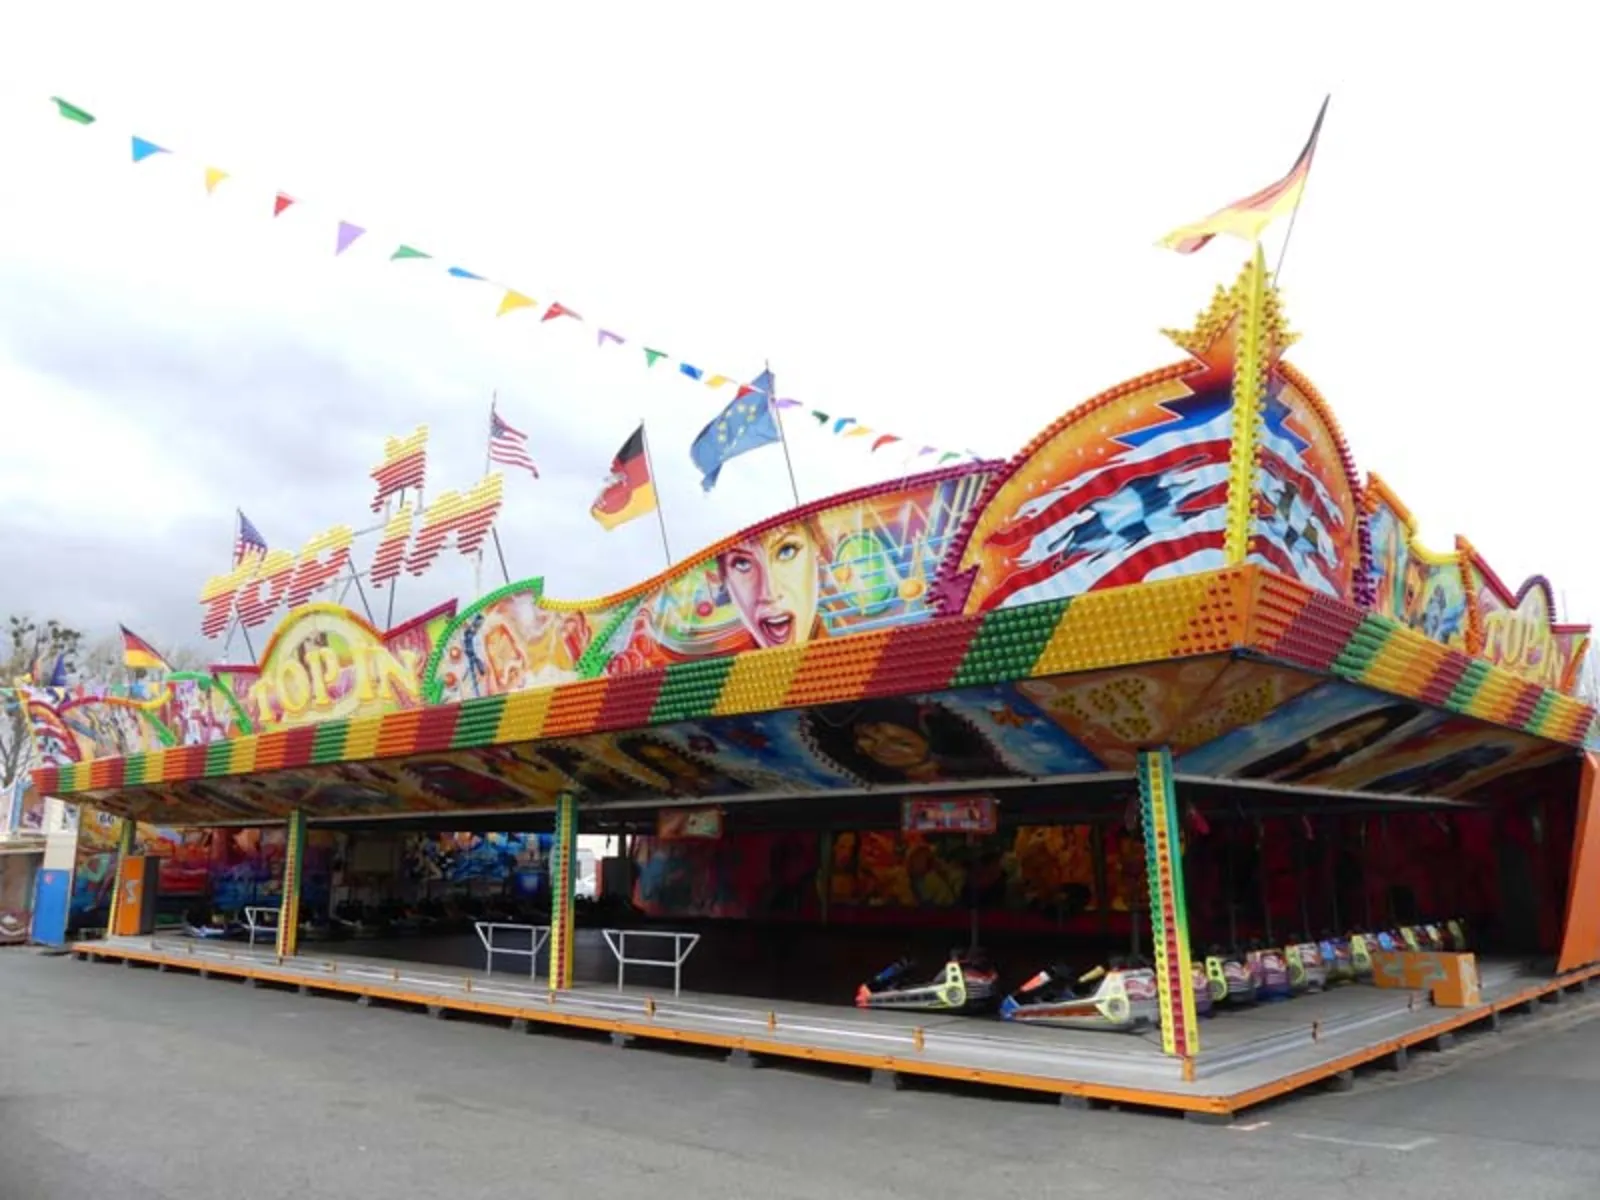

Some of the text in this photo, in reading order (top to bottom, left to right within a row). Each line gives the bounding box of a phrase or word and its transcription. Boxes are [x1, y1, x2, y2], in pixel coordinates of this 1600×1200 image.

[200, 473, 502, 639] TOP IN
[249, 643, 422, 722] TOP IN
